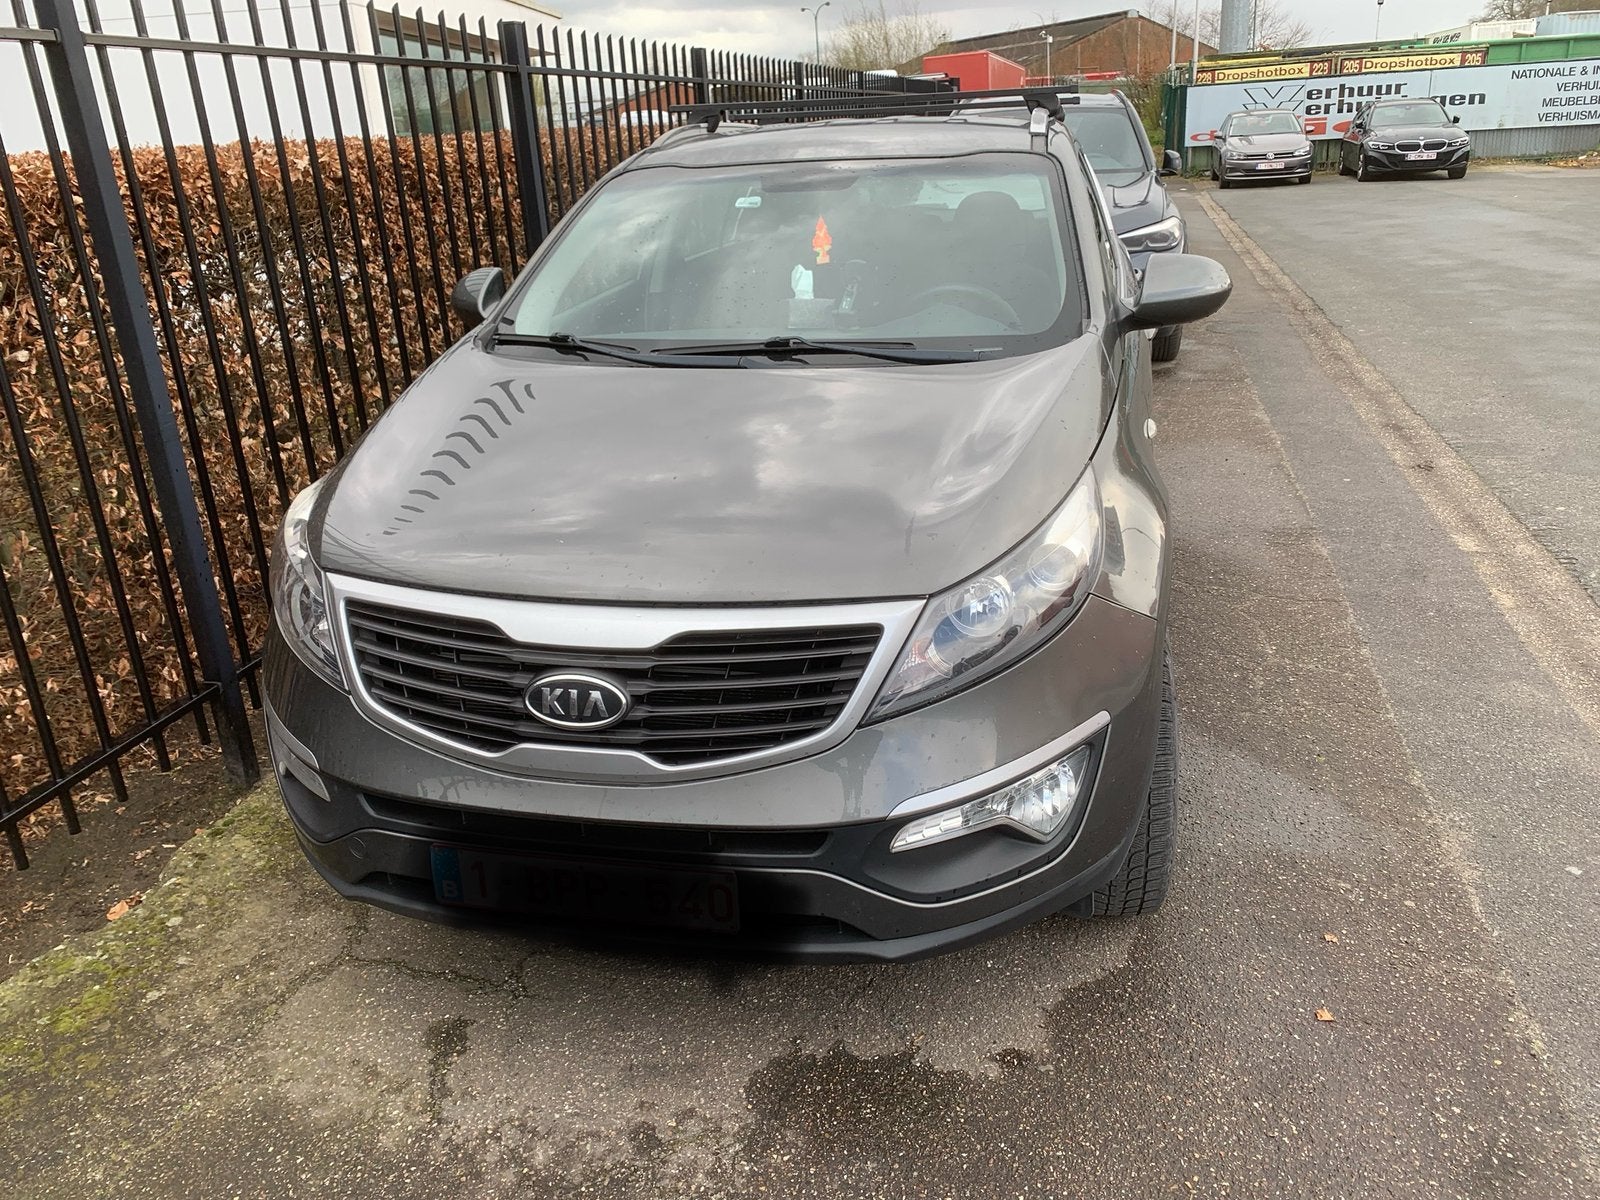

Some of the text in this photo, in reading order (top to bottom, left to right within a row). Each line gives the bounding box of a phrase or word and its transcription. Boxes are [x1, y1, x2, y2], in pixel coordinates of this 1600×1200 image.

[1343, 53, 1482, 74] 205 Dropshotbox 205
[1216, 67, 1304, 81] Dropshotbox
[1511, 66, 1577, 79] NATIONALE
[1580, 65, 1588, 76] &
[1556, 80, 1600, 92] VERHUI
[541, 687, 609, 718] KIA
[442, 880, 458, 898] B
